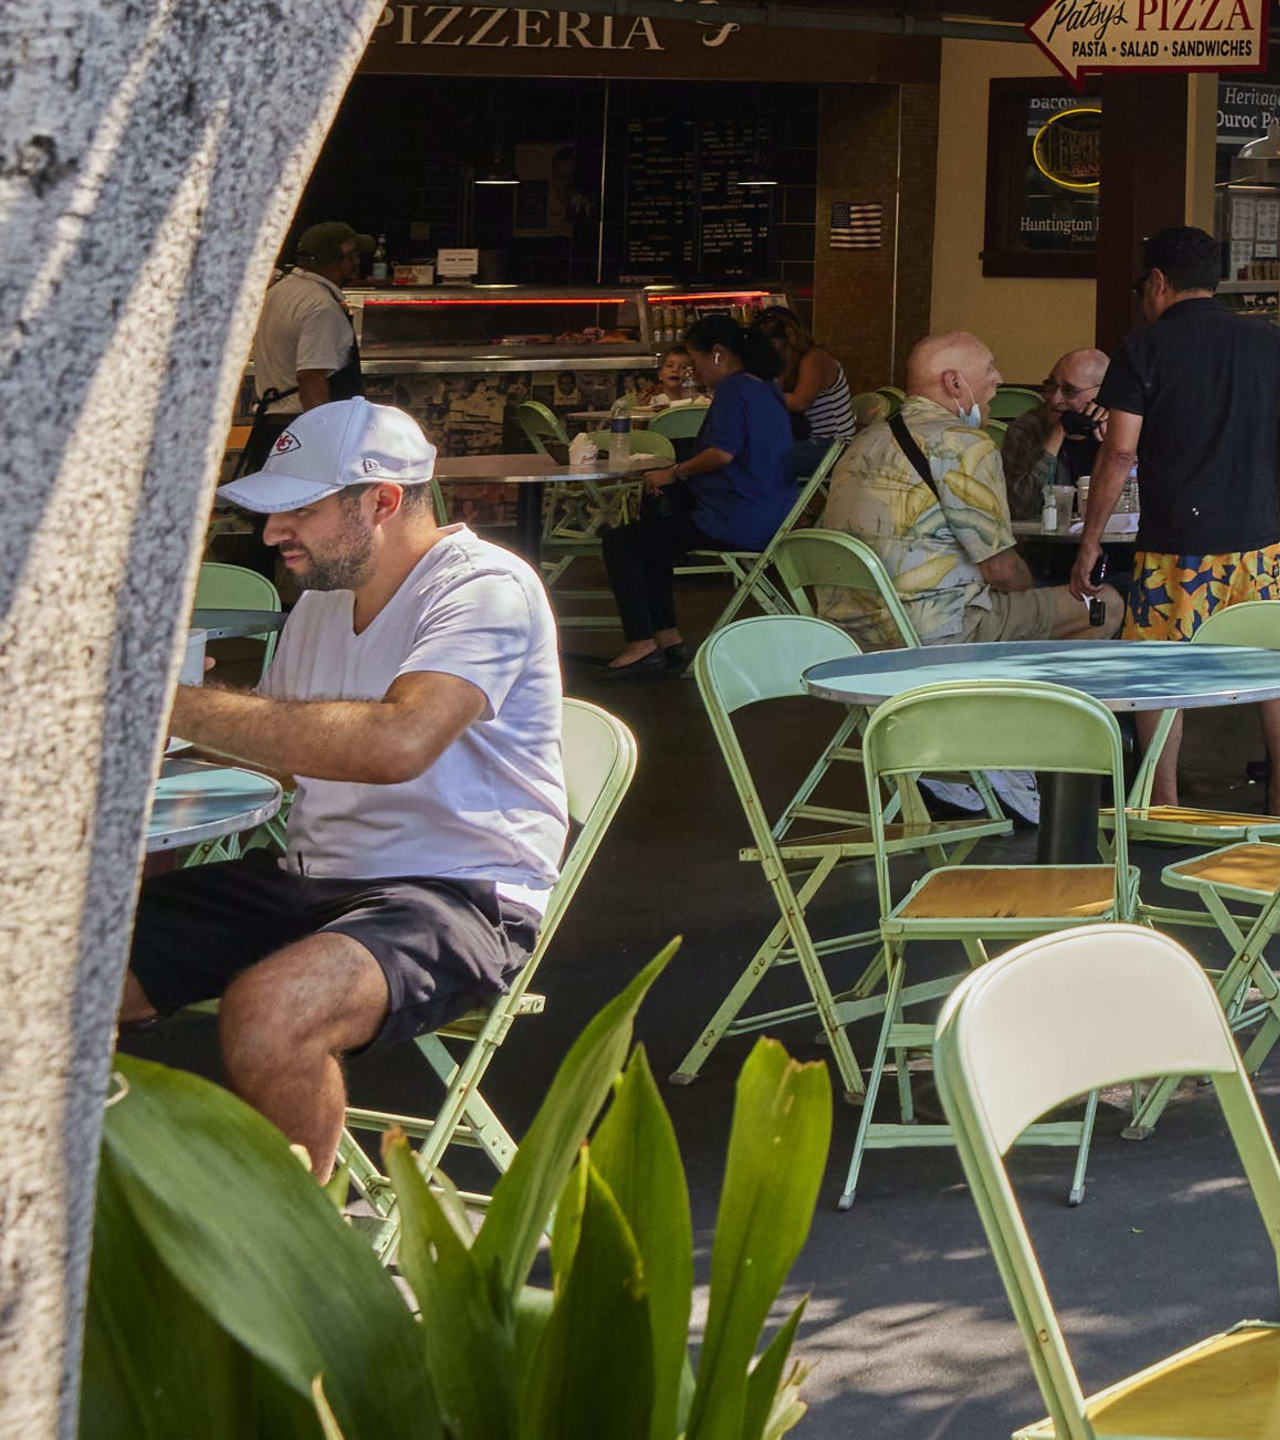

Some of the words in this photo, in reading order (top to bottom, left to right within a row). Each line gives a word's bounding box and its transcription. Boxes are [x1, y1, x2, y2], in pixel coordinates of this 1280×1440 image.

[1072, 41, 1107, 57] PASTA
[1120, 40, 1159, 57] SALAD
[1172, 40, 1252, 57] SANDWICHES
[1019, 215, 1093, 235] Huntington
